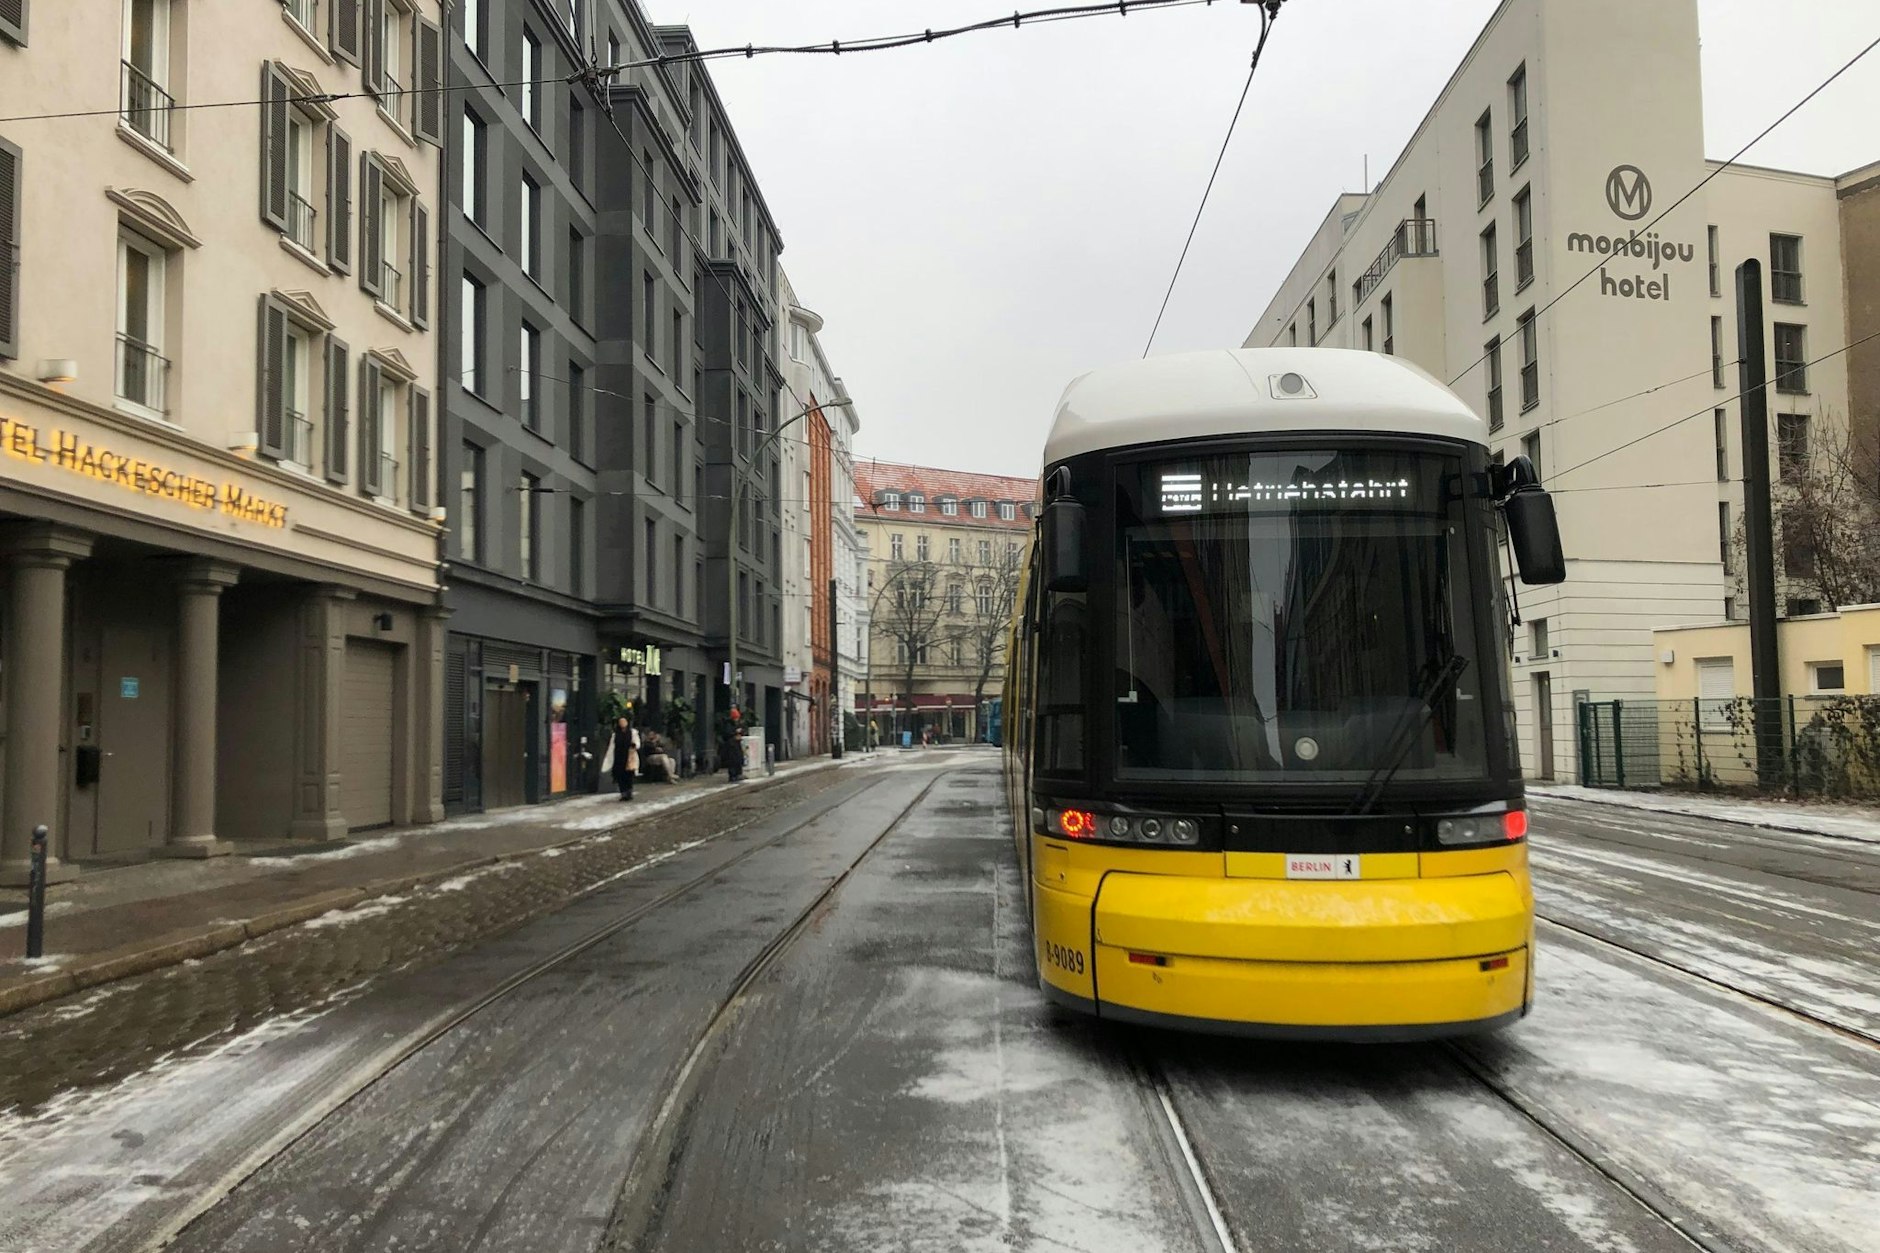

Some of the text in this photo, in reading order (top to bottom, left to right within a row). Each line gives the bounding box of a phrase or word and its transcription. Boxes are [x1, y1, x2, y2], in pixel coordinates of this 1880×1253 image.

[1610, 169, 1648, 217] M
[1567, 229, 1694, 270] monbijou
[1600, 266, 1669, 301] hotel
[620, 647, 646, 665] HOTEL
[1290, 861, 1332, 873] BERLIN
